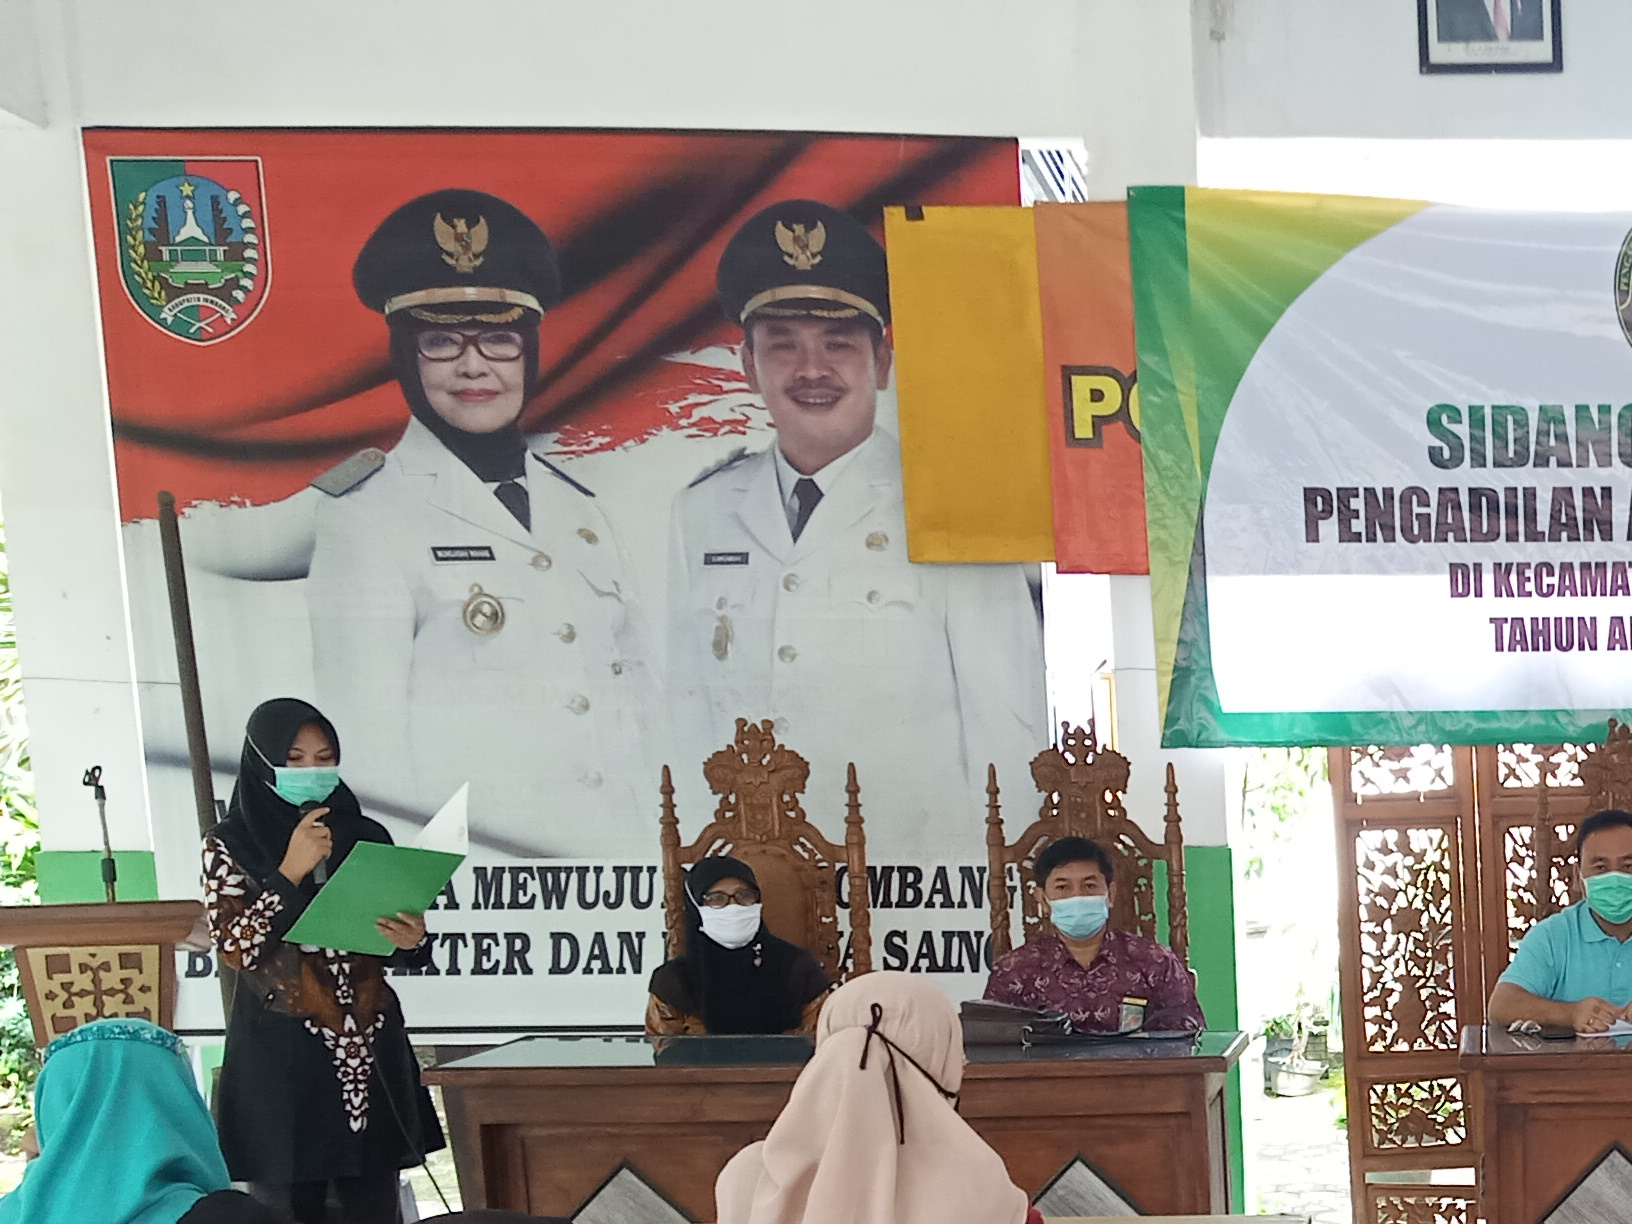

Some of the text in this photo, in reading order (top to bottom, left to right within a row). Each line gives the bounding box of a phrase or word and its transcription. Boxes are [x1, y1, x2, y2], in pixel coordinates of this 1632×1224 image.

[1062, 366, 1141, 448] P
[1303, 486, 1614, 544] PENGADILAN
[1448, 562, 1482, 598] DI
[1489, 616, 1598, 652] TAHUN
[472, 866, 667, 910] MEWUJU
[548, 931, 645, 975] DAN
[882, 930, 993, 974] SAIN
